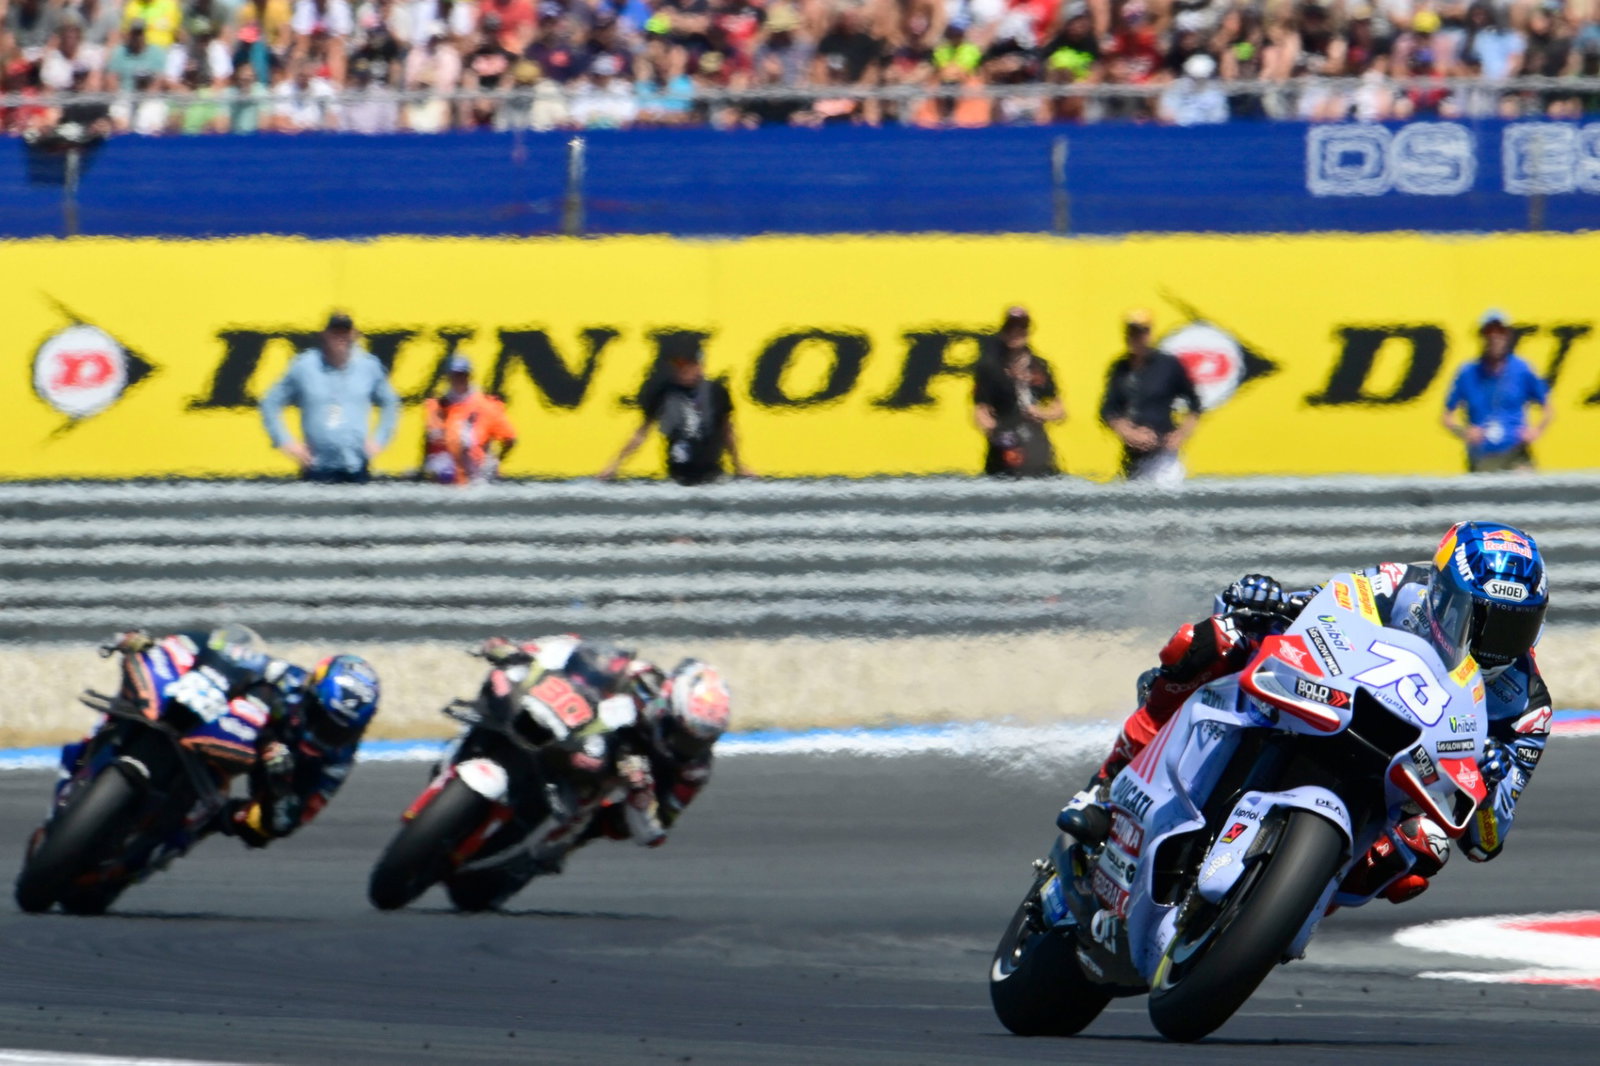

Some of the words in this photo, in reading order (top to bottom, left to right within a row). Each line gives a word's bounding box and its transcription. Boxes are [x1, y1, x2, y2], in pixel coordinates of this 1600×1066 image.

[1306, 121, 1476, 196] DS
[1484, 540, 1509, 553] Red
[1508, 541, 1533, 559] Bull
[1491, 583, 1524, 600] SHOEI
[1317, 614, 1350, 652] Unibat
[1298, 679, 1329, 699] BOLD
[1349, 640, 1452, 728] 73
[1449, 716, 1478, 733] Unibat
[1416, 746, 1434, 777] BOLD
[1113, 775, 1154, 822] DUCATI
